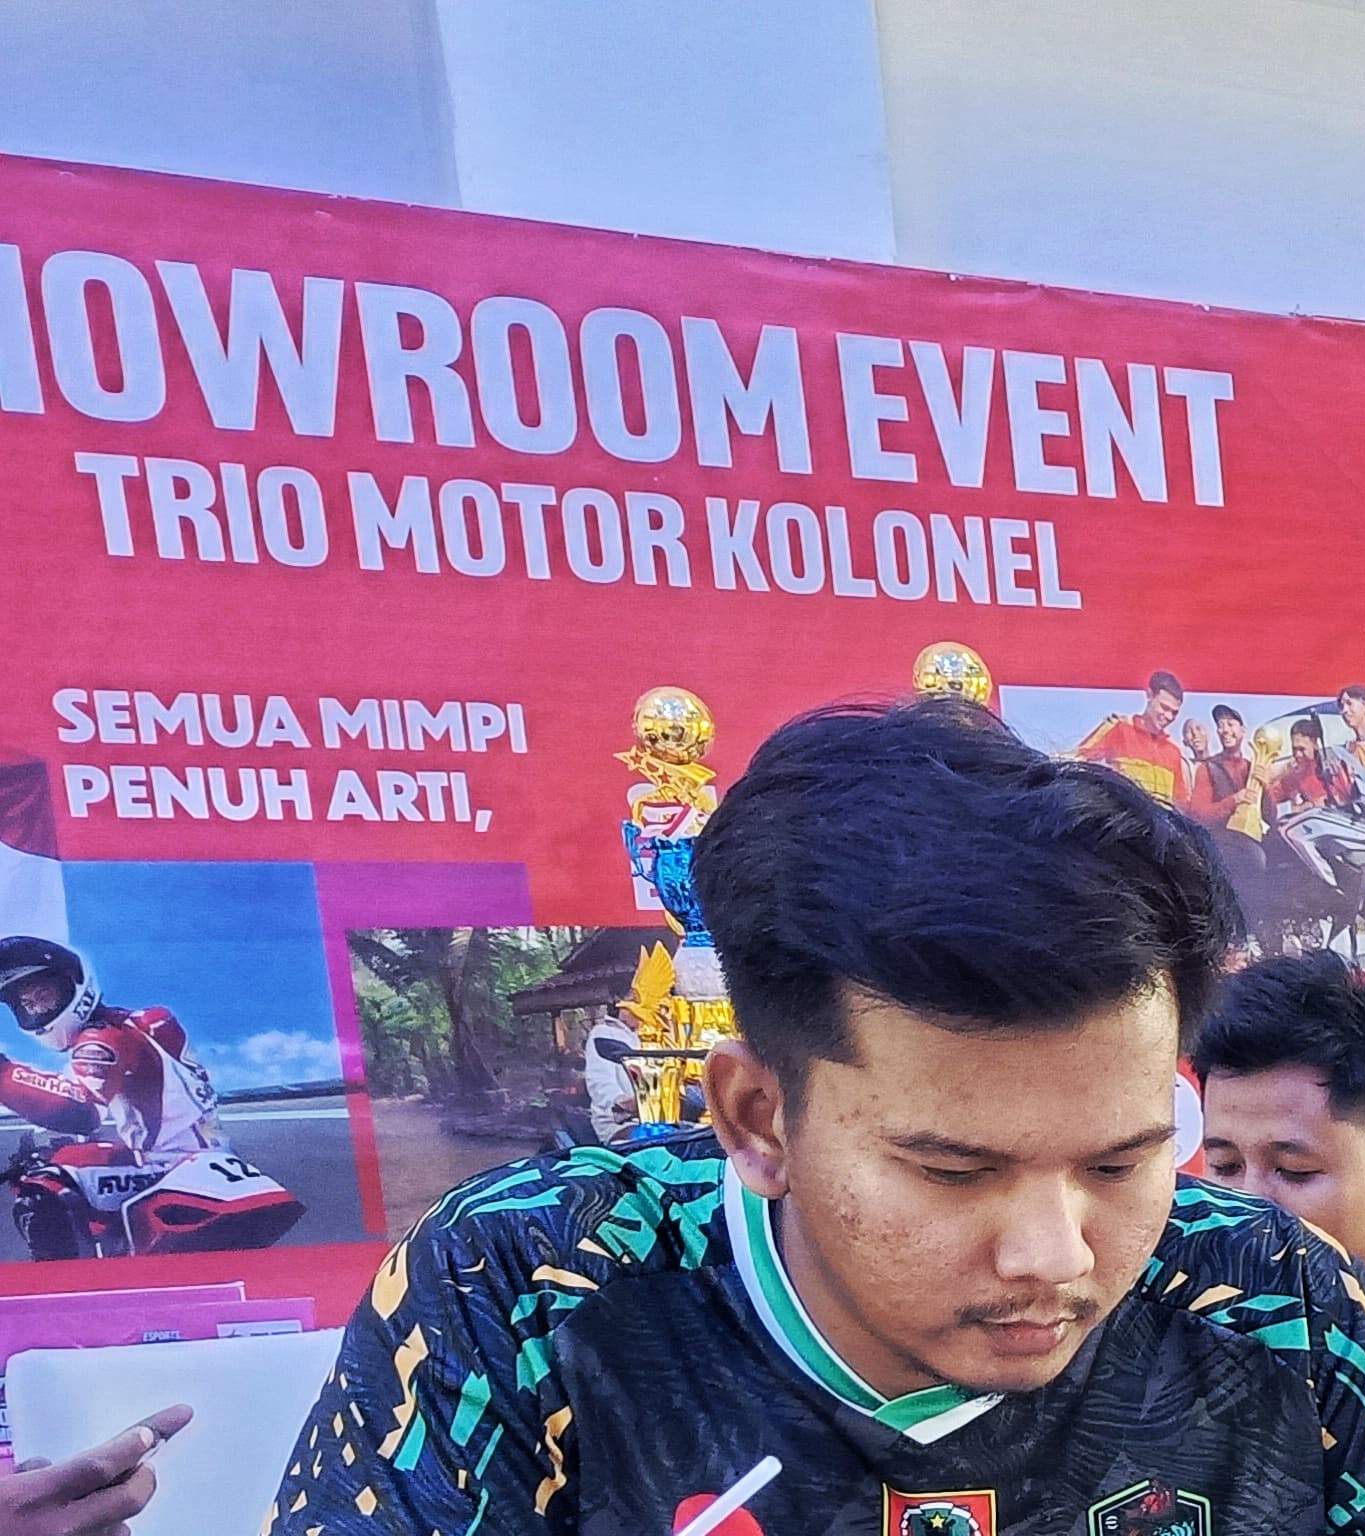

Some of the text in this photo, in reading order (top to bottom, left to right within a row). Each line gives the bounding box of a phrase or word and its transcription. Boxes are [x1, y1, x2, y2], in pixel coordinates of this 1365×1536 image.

[836, 332, 1235, 508] EVENT
[75, 452, 1082, 610] TRIO MOTOR KOLONEL
[52, 688, 529, 753] SEMUA MIMPI
[62, 764, 493, 832] PENUH ARTI,
[208, 1157, 262, 1183] 12
